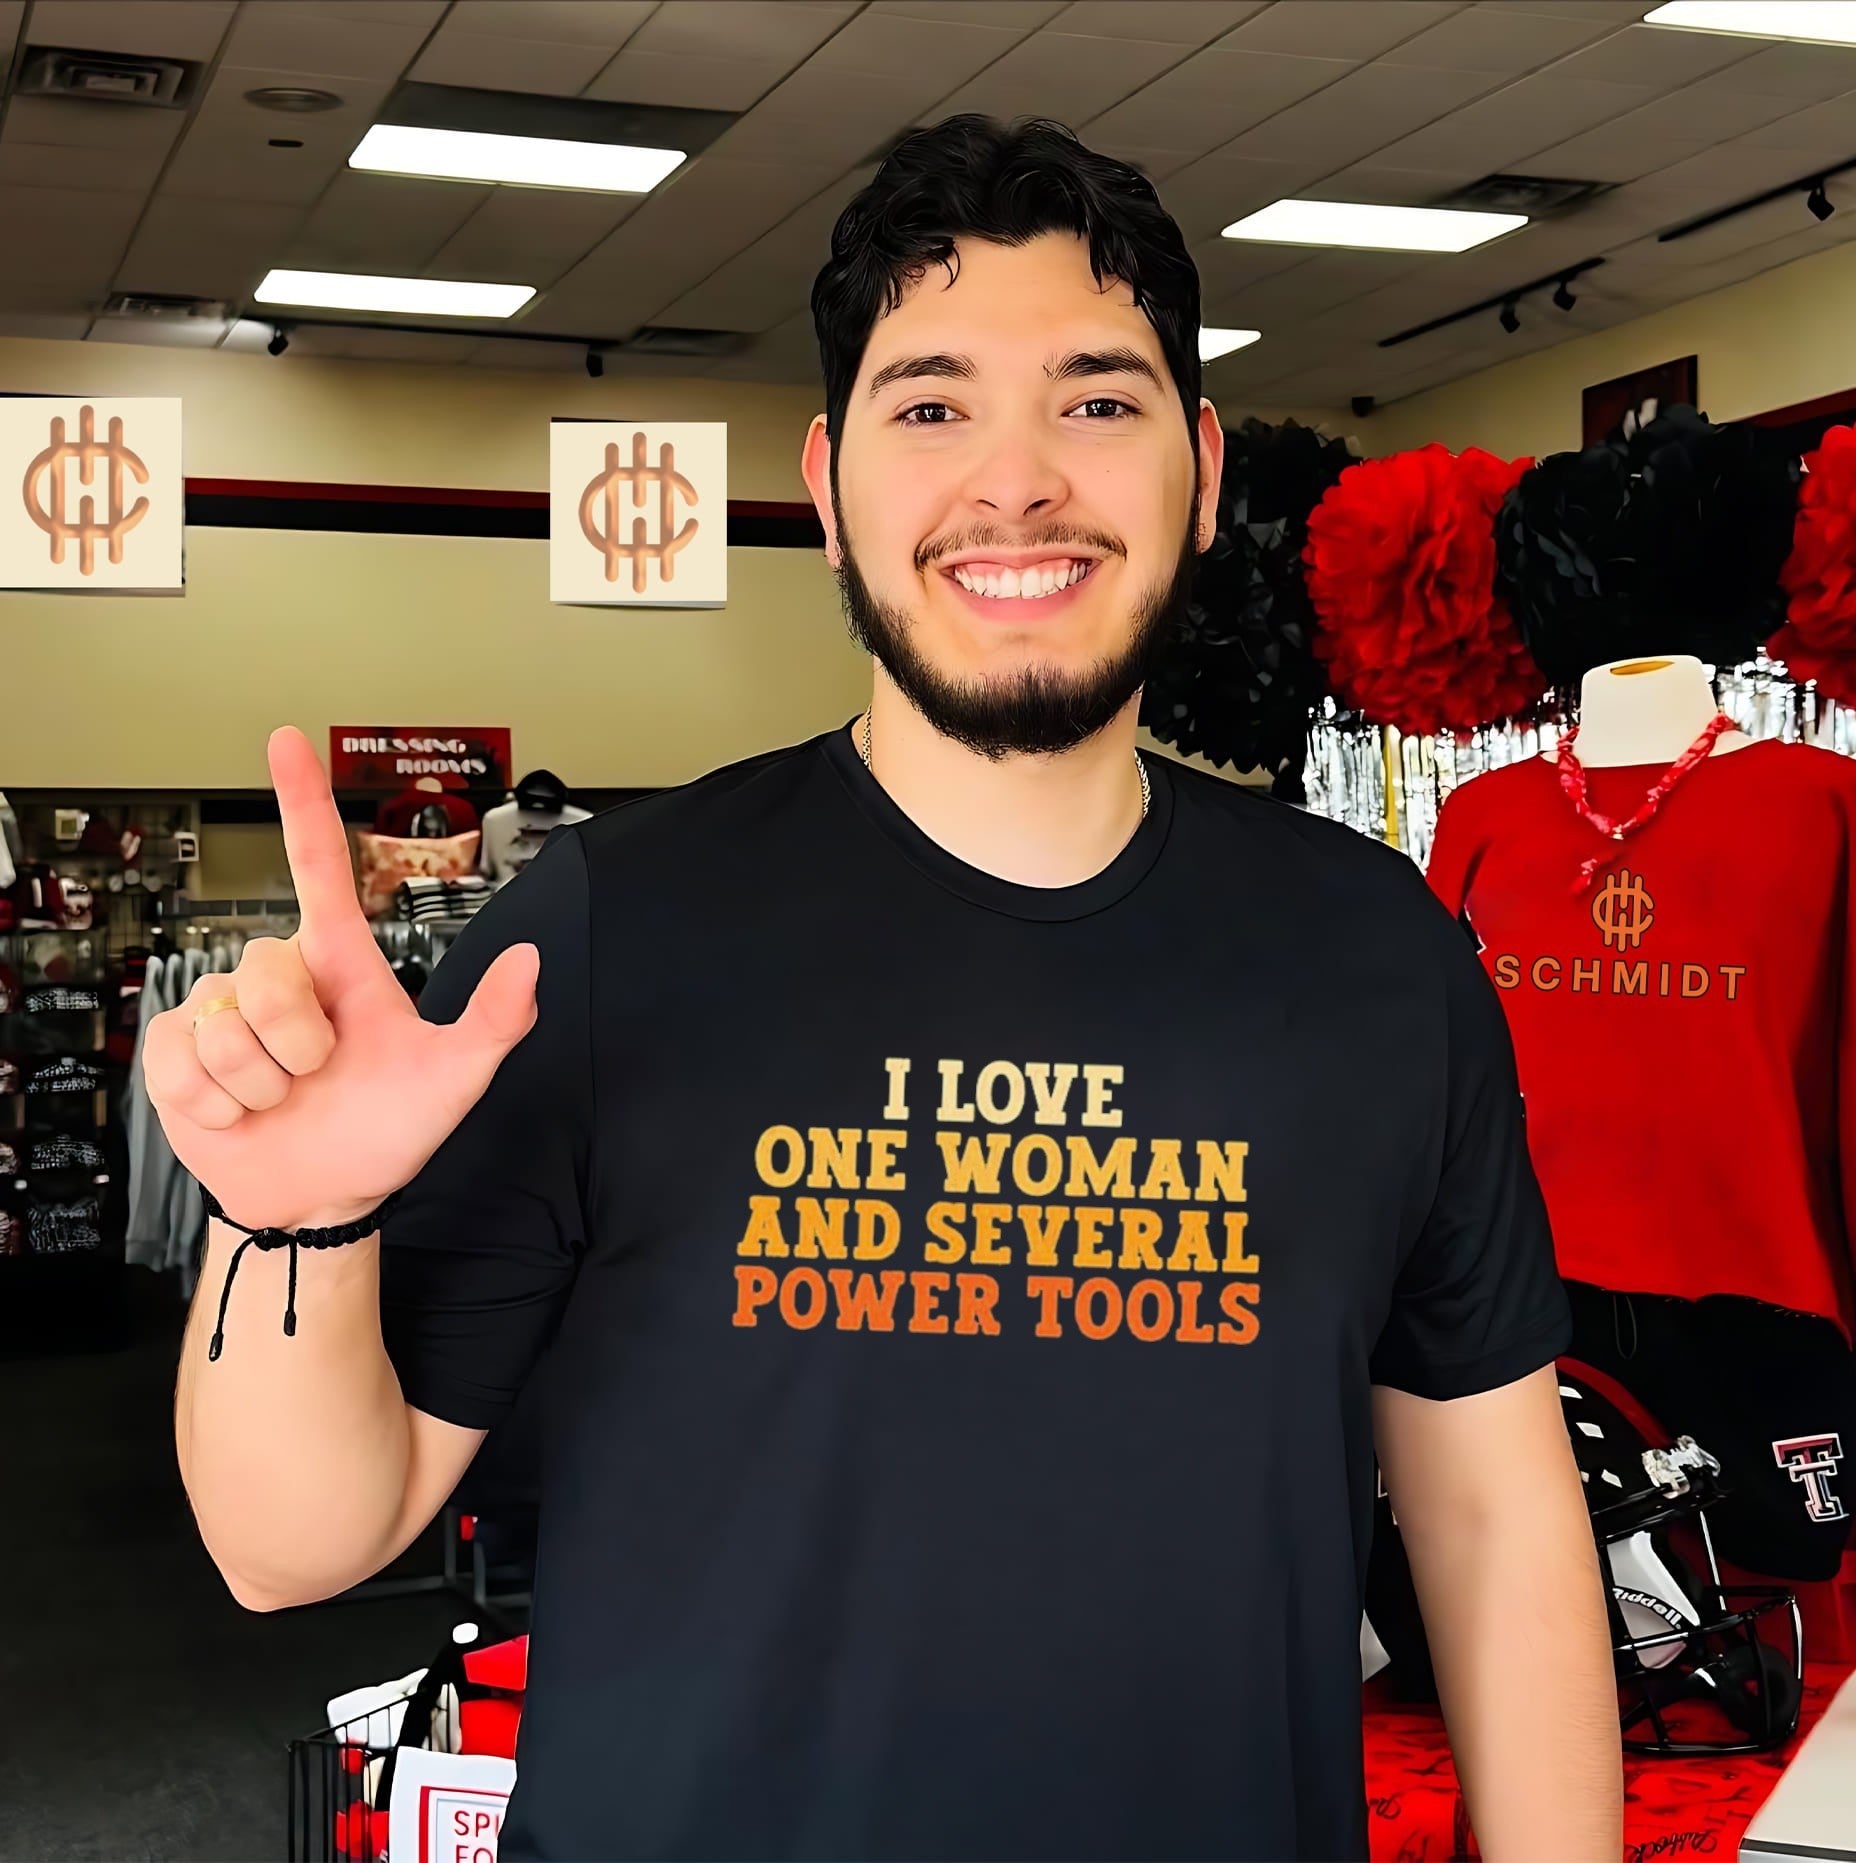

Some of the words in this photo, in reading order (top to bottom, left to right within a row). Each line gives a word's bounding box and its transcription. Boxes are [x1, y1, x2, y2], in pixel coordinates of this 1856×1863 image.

[1494, 953, 1747, 1000] SCHMIDT
[884, 1058, 910, 1120] I
[937, 1059, 1124, 1127] LOVE
[755, 1125, 907, 1190] ONE
[936, 1131, 1248, 1202] WOMAN
[737, 1195, 901, 1260] AND
[924, 1201, 1259, 1273] SEVERAL
[732, 1265, 1001, 1335] POWER
[1027, 1276, 1260, 1345] TOOLS
